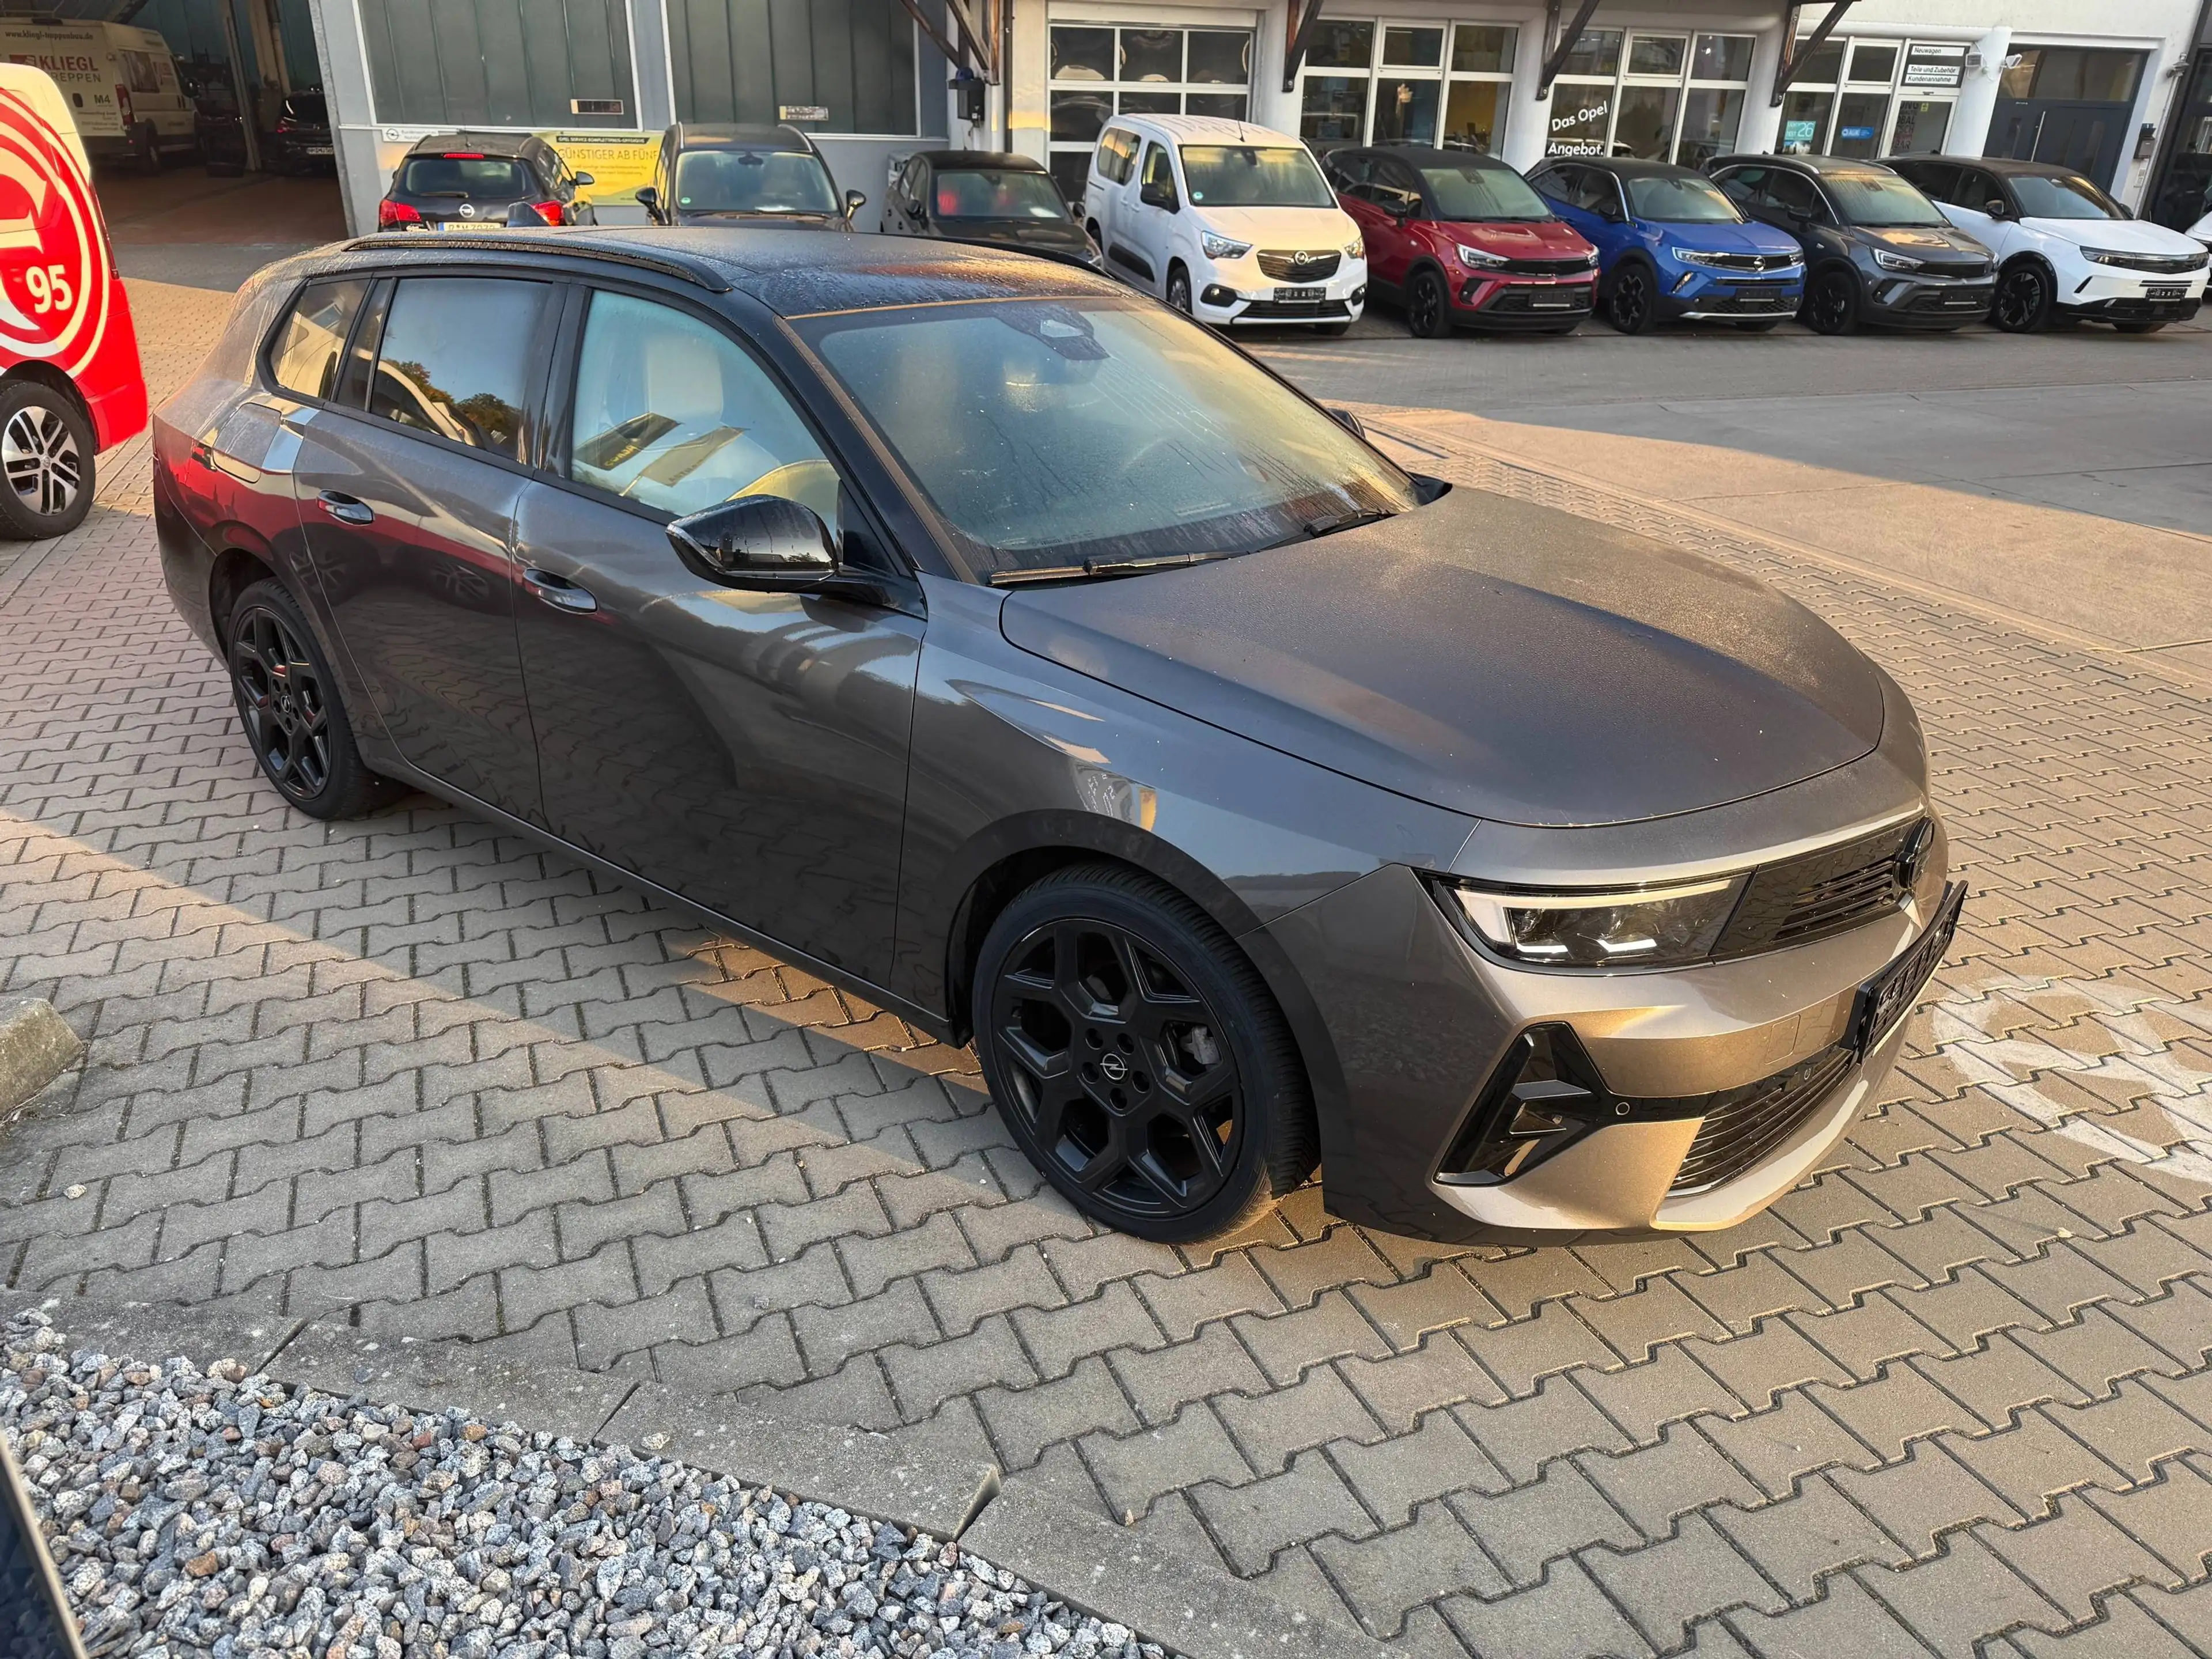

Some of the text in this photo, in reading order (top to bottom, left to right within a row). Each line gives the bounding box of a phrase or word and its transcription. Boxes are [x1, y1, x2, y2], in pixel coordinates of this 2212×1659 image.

[1914, 47, 1941, 56] Neuwagen
[40, 55, 99, 71] KLIEGL
[50, 71, 101, 83] REPPEN
[94, 94, 111, 104] M4
[1552, 100, 1608, 131] Das Opel
[1797, 122, 1814, 138] 26
[558, 147, 615, 160] GÜNSTIGER
[617, 151, 630, 160] AB
[1547, 142, 1604, 157] Angebot.
[26, 264, 73, 313] 95
